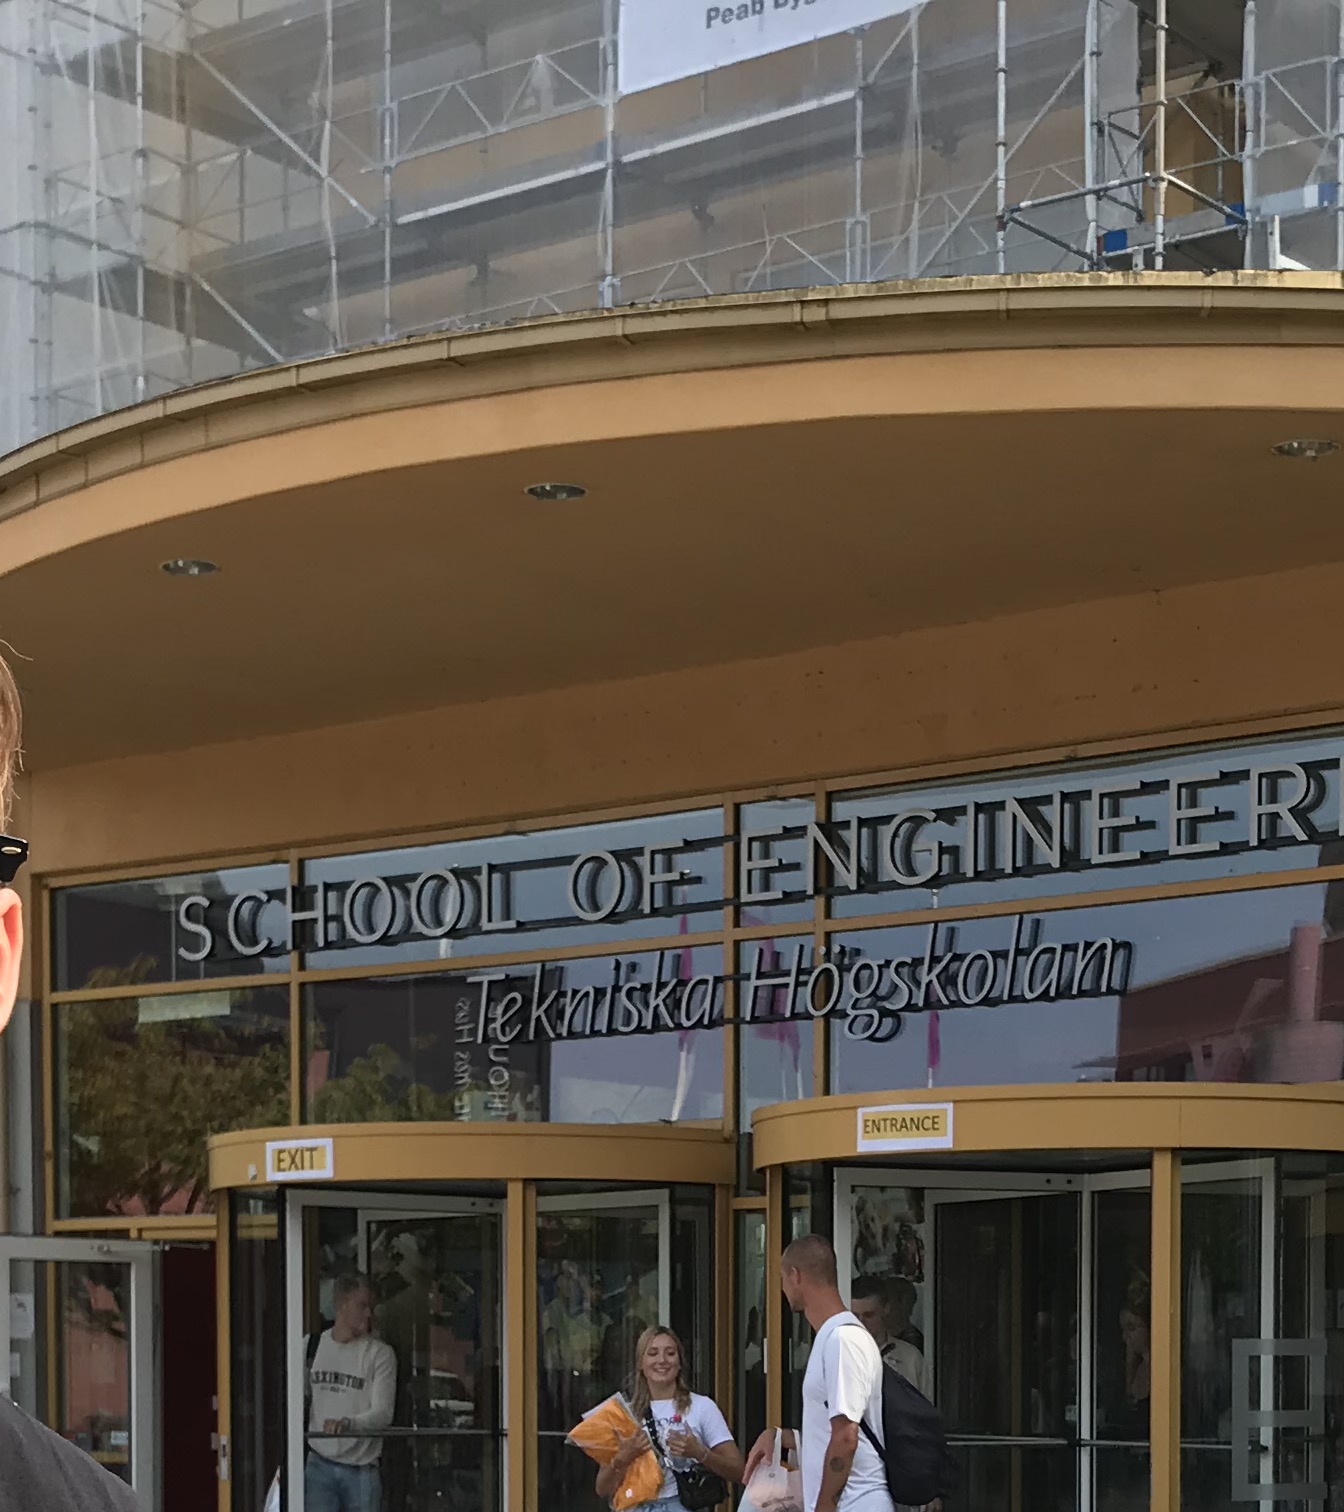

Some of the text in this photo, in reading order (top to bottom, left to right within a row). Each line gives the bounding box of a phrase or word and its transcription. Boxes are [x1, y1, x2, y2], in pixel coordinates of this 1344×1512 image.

[705, 0, 765, 29] Peab
[178, 863, 517, 962] SCHOOL
[567, 839, 690, 923] OF
[466, 915, 1118, 1046] Tekniska Högskolan
[862, 1113, 941, 1136] ENTRANCE
[275, 1146, 319, 1174] EXIT
